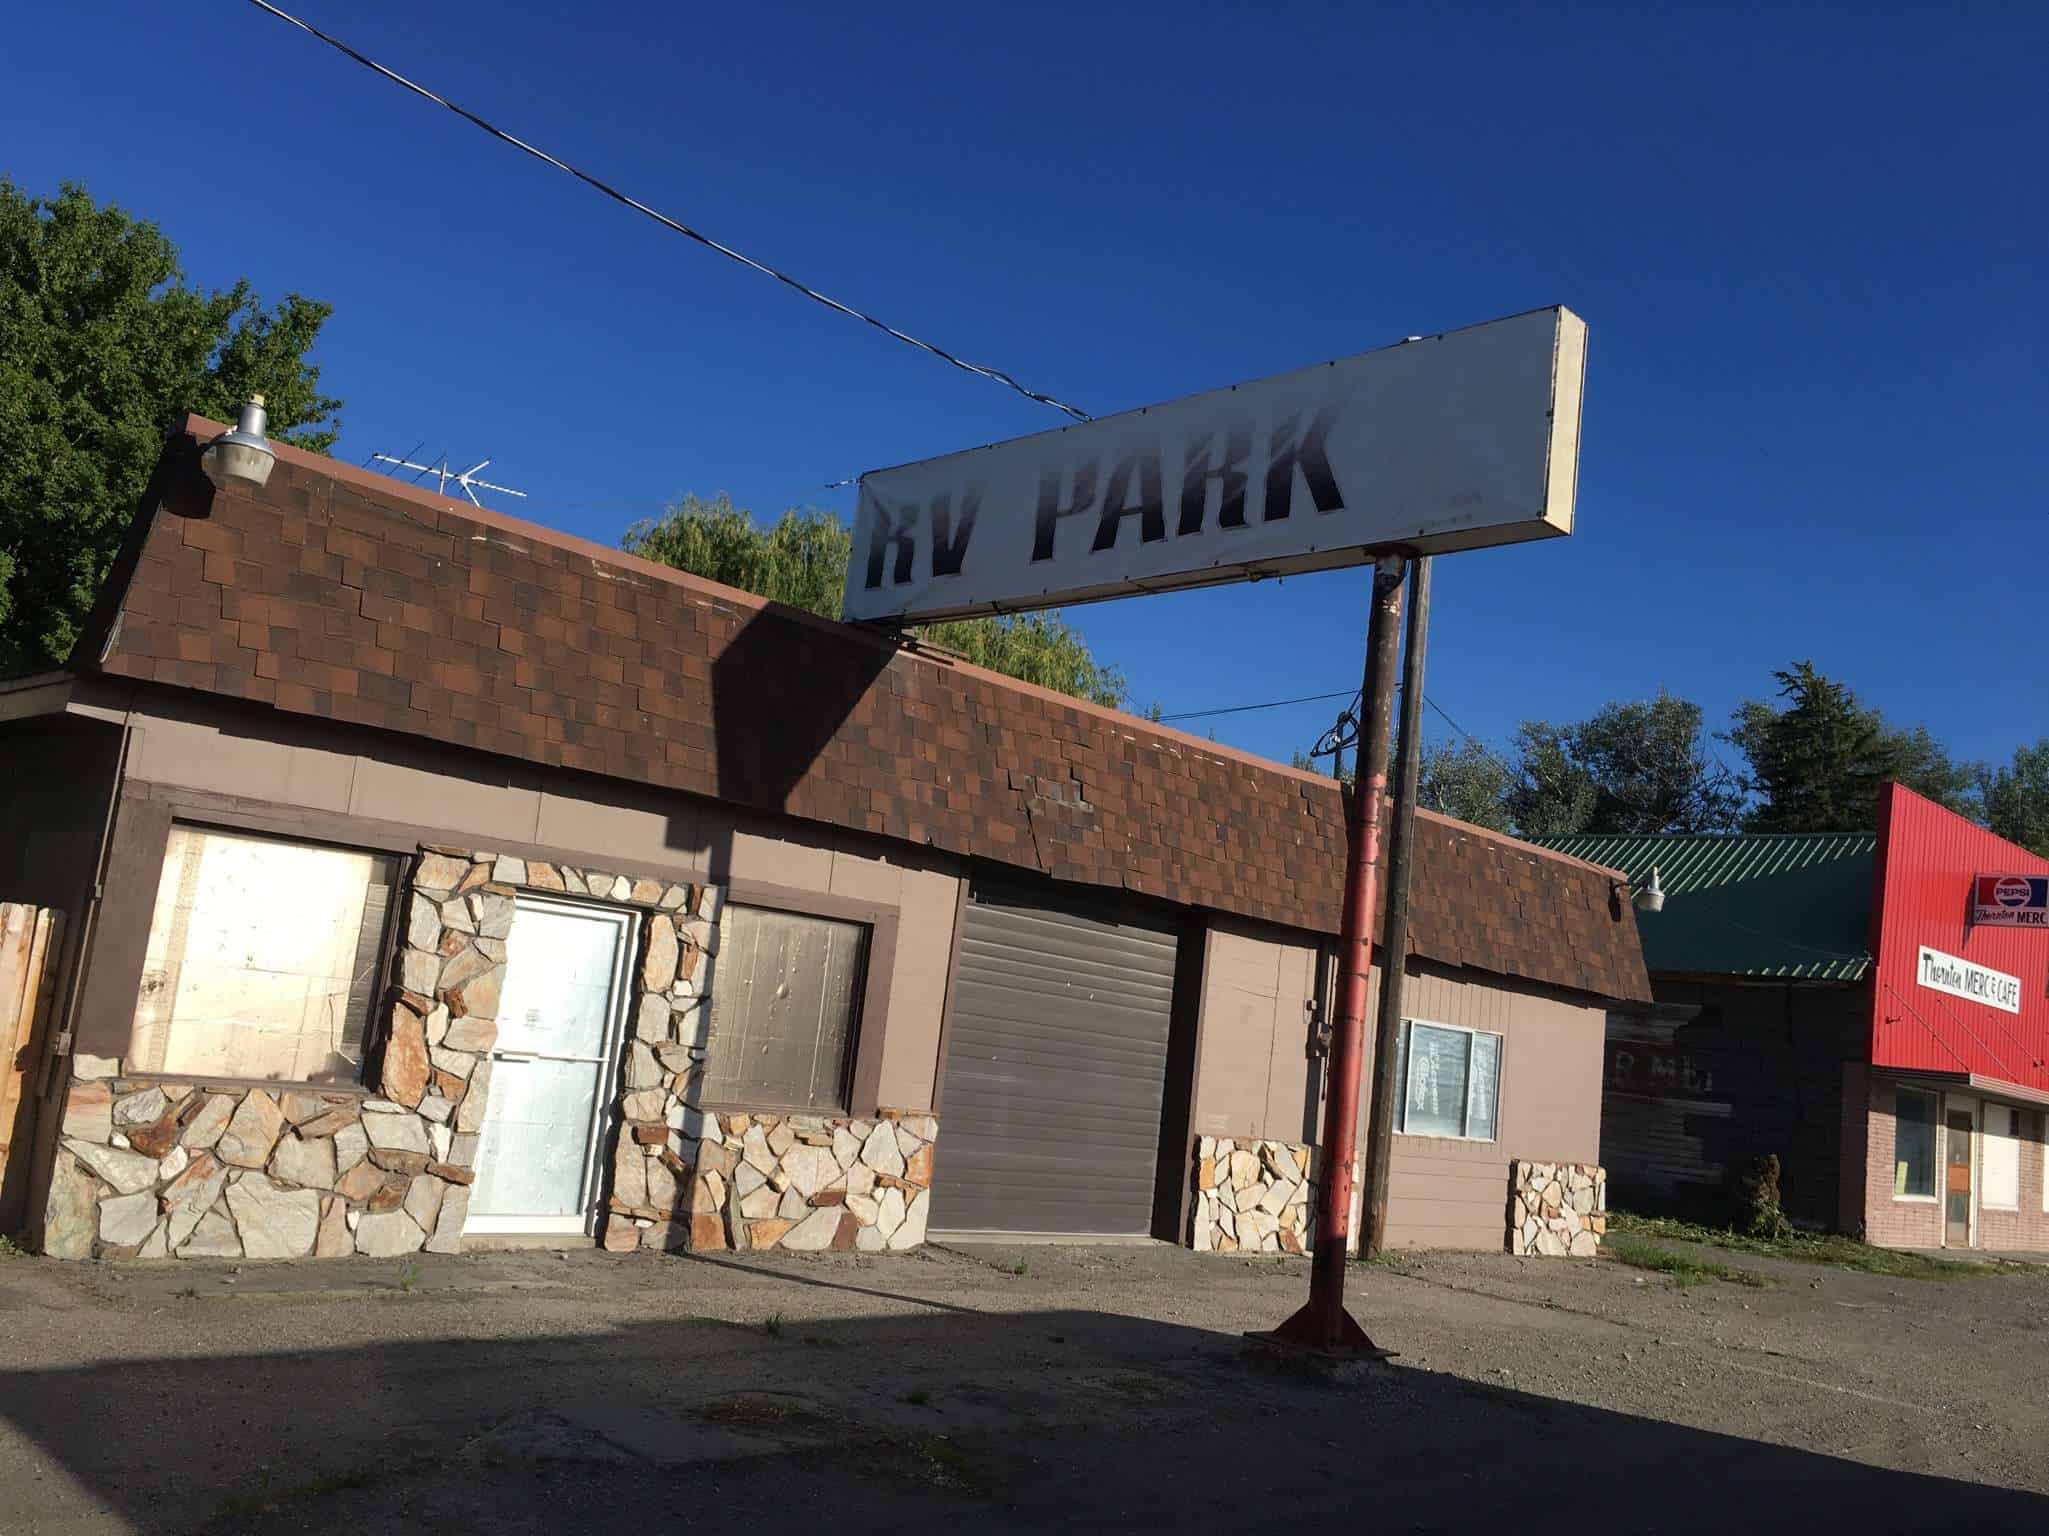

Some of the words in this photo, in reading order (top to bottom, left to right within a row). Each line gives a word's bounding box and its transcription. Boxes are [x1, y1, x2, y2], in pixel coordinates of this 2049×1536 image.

[864, 484, 988, 588] RV
[1031, 402, 1346, 563] PARK
[1995, 887, 2030, 897] PEPSI
[2016, 911, 2048, 924] MERC
[1963, 967, 1989, 998] MERC
[1998, 978, 2018, 1007] CAFE
